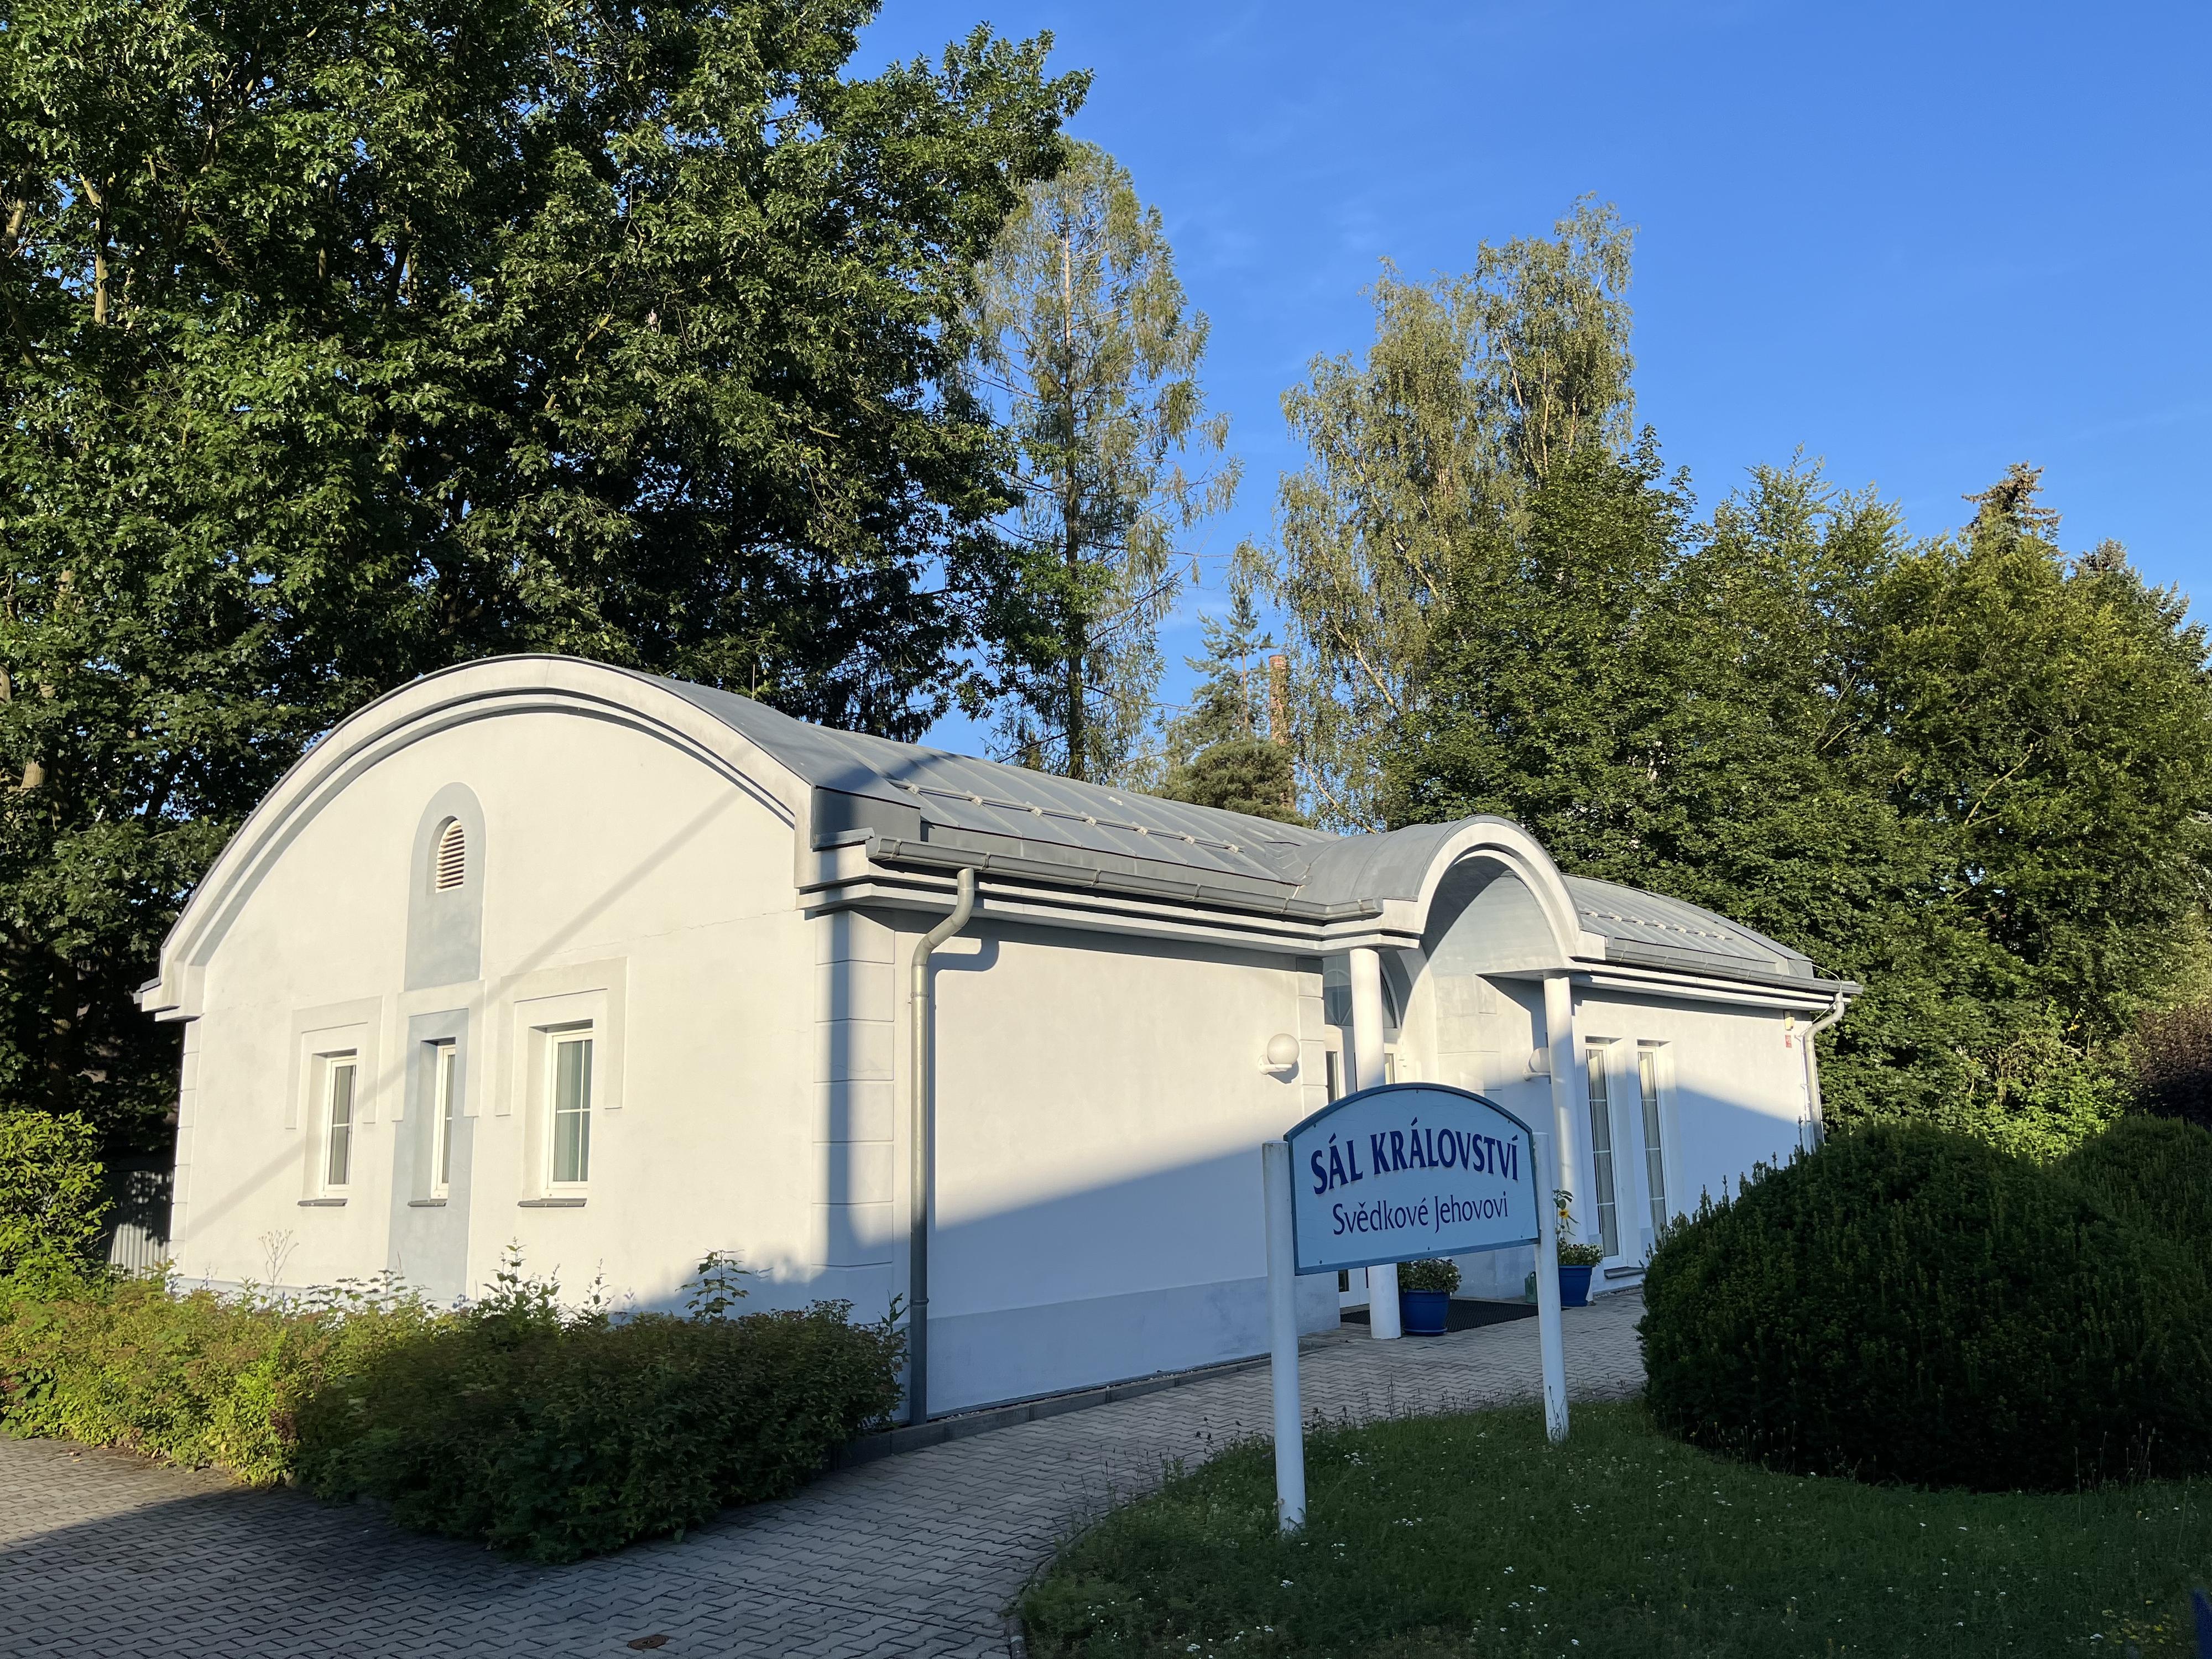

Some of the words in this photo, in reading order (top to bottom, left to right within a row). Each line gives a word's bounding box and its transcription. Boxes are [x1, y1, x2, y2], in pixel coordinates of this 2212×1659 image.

[1311, 1133, 1363, 1194] SÁL
[1370, 1117, 1518, 1181] KRÁLOVSTVÍ
[1333, 1197, 1428, 1235] Svědkové
[1434, 1191, 1508, 1234] Jehovovi
